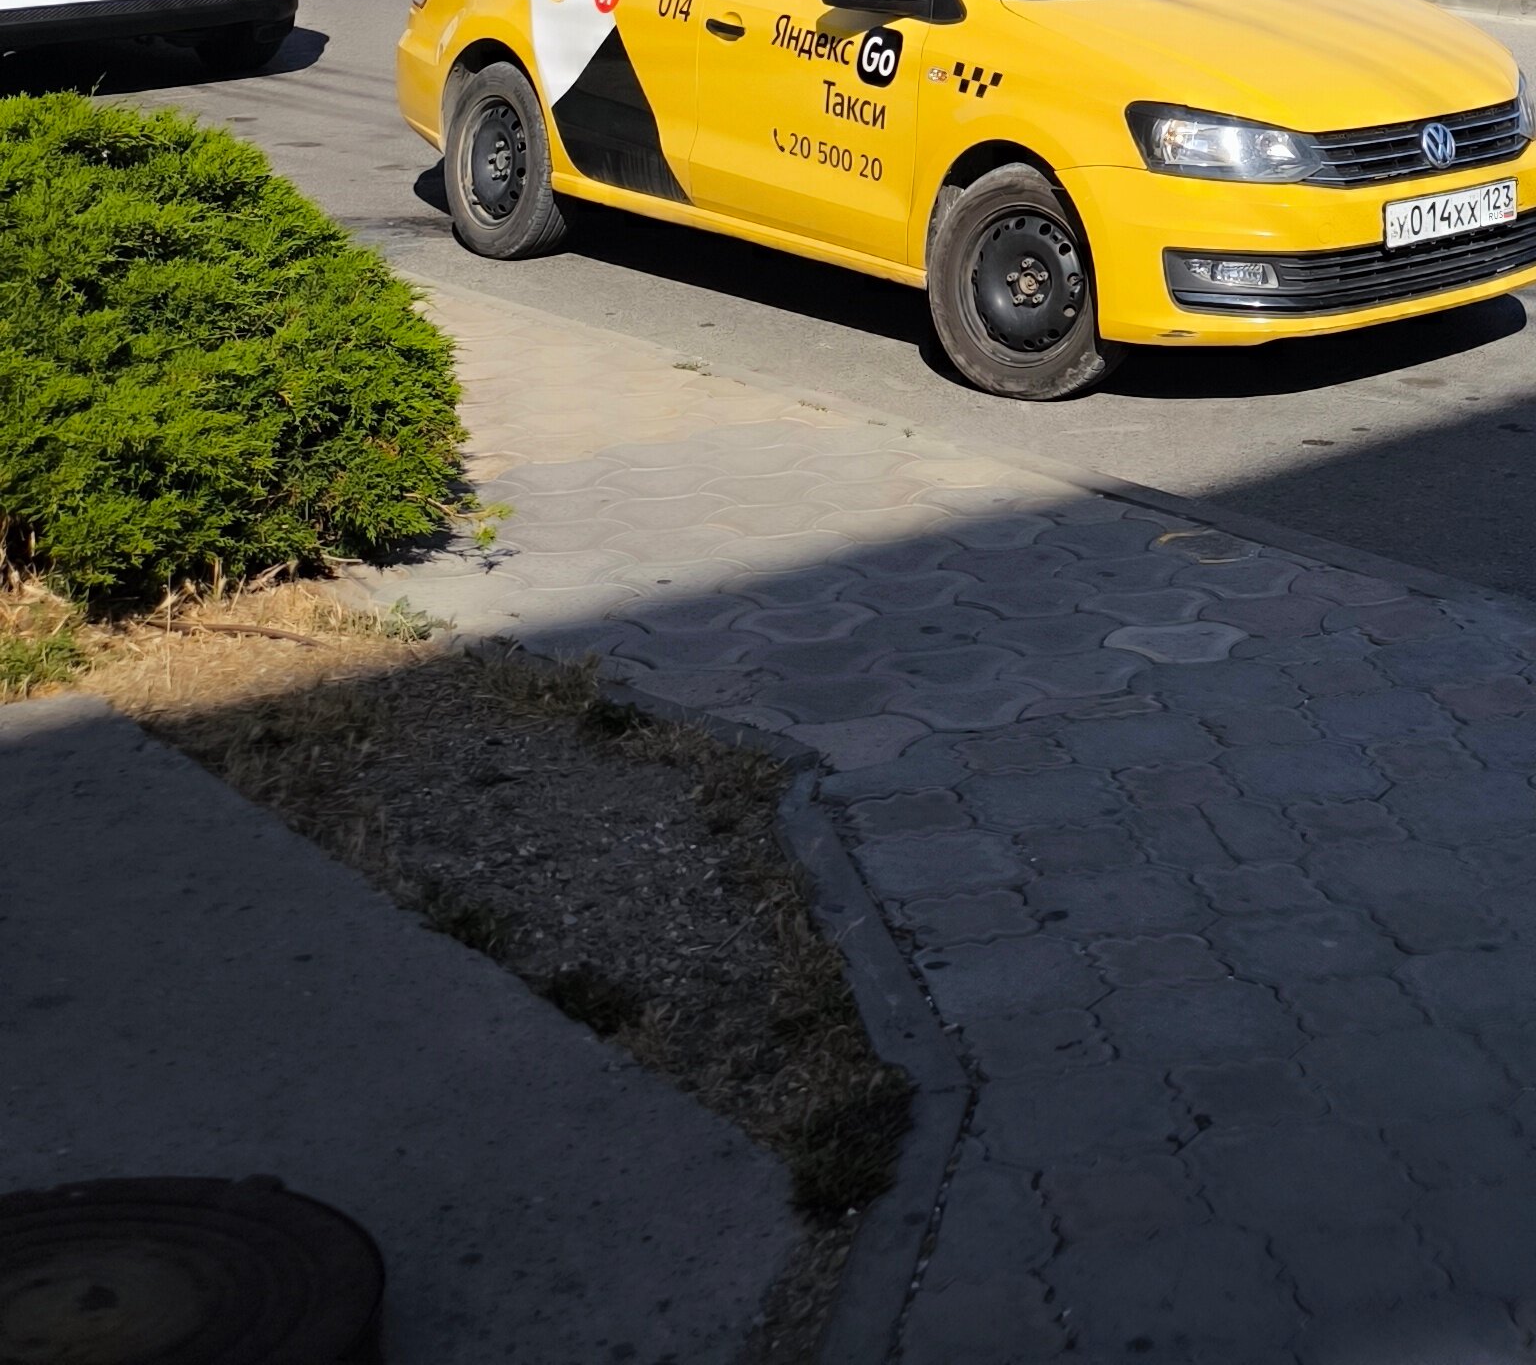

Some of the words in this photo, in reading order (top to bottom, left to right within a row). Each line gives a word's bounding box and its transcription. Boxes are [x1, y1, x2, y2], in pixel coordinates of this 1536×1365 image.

[771, 14, 854, 65] Яндекс
[862, 36, 896, 77] Go
[823, 79, 886, 130] Такси
[789, 132, 811, 159] 20
[817, 141, 853, 172] 500
[859, 154, 883, 181] 20
[1483, 184, 1511, 211] 123
[1488, 212, 1504, 221] RUS
